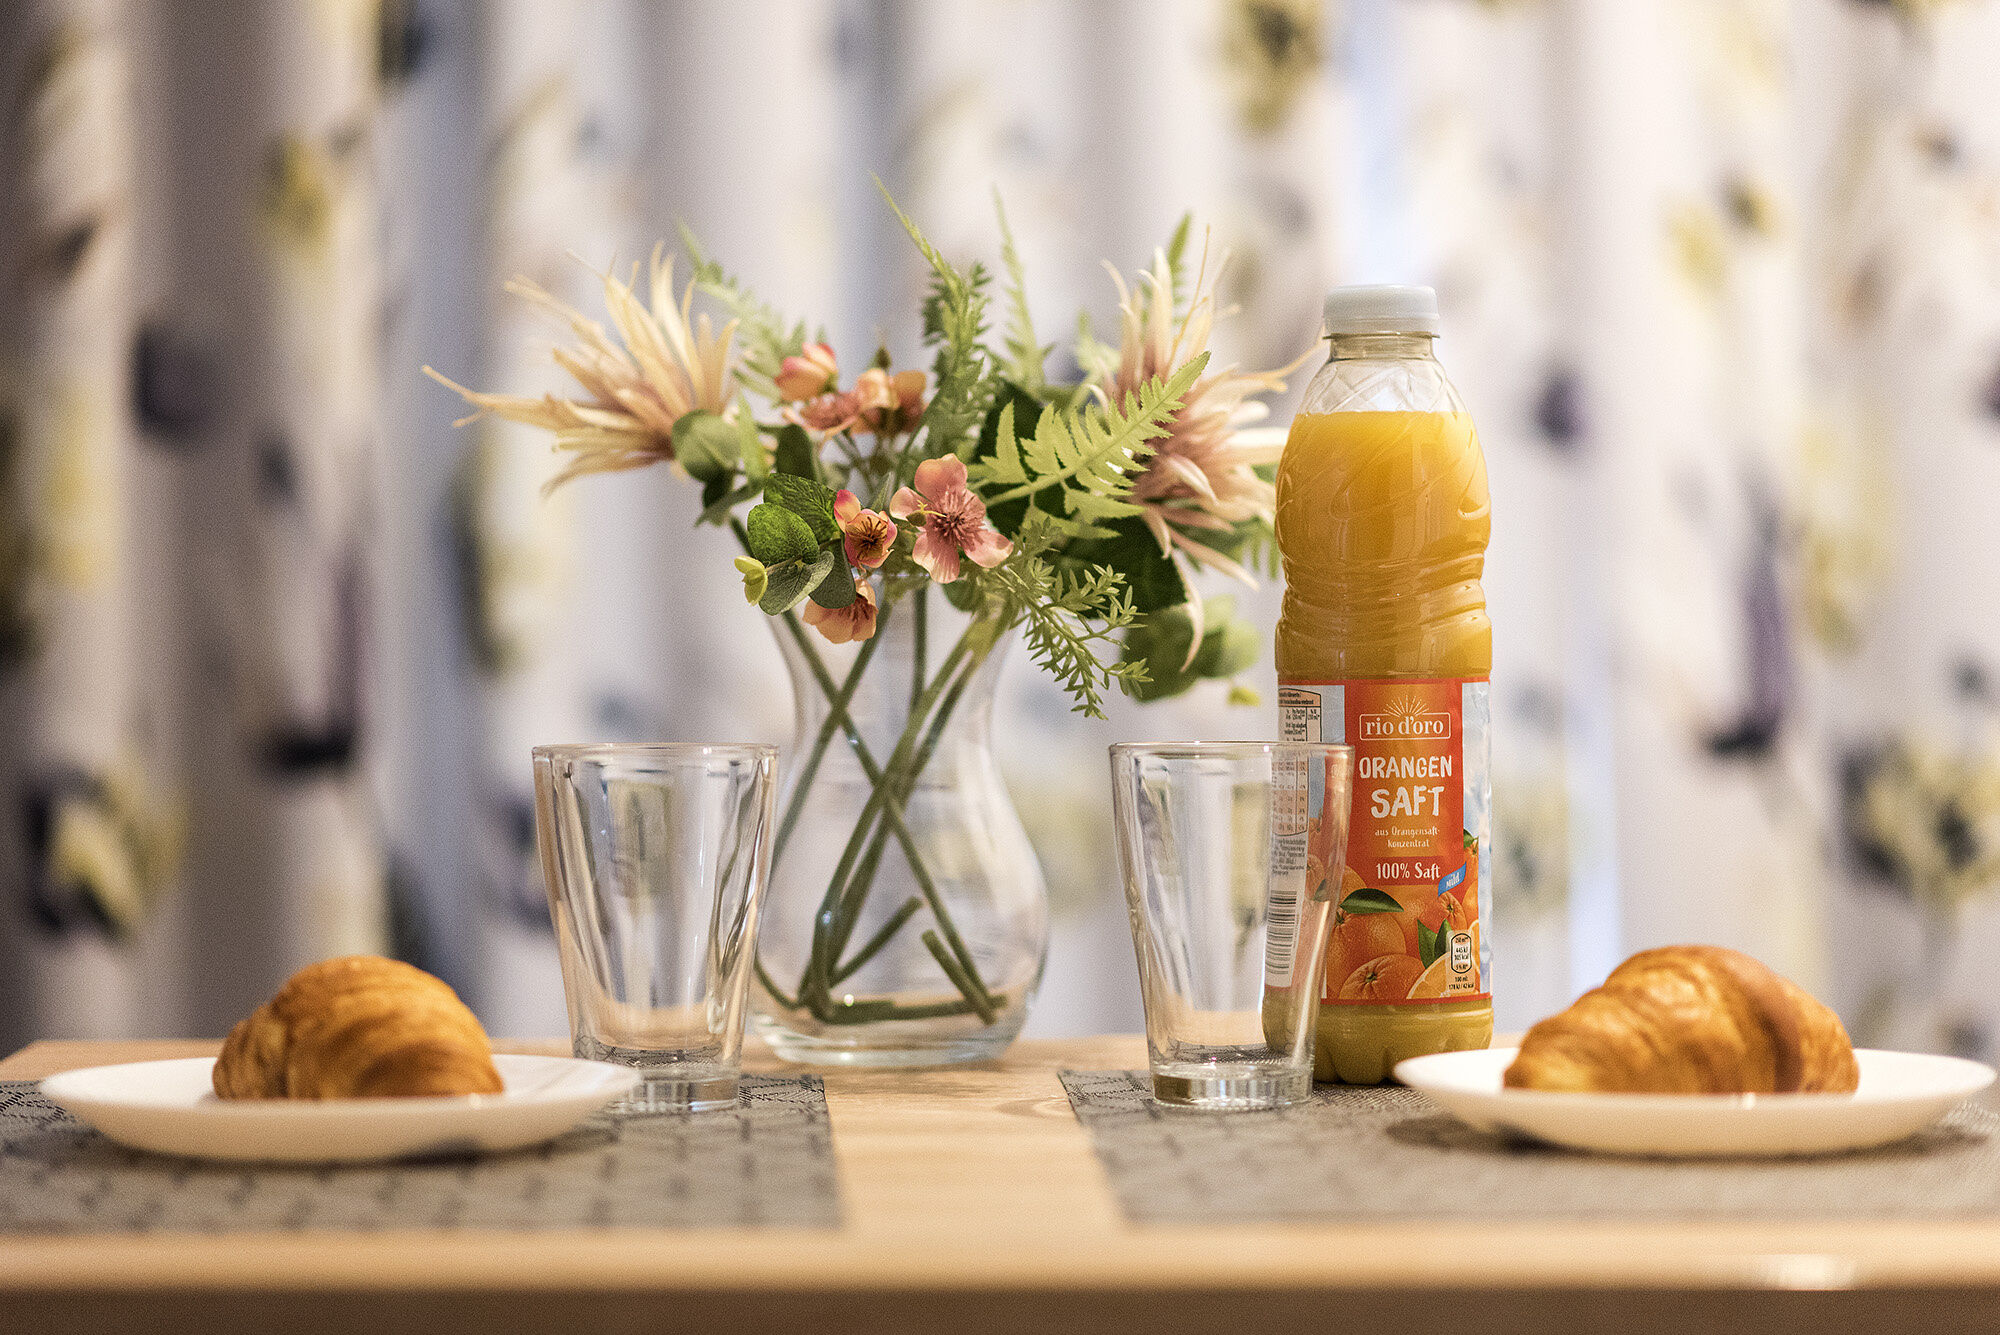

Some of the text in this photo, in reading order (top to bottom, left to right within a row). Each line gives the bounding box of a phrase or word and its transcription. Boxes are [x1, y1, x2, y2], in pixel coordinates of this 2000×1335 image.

[1365, 716, 1394, 735] rio
[1359, 755, 1452, 779] ORANGEN
[1370, 785, 1445, 819] SAFT
[1376, 861, 1441, 880] 100% Saft
